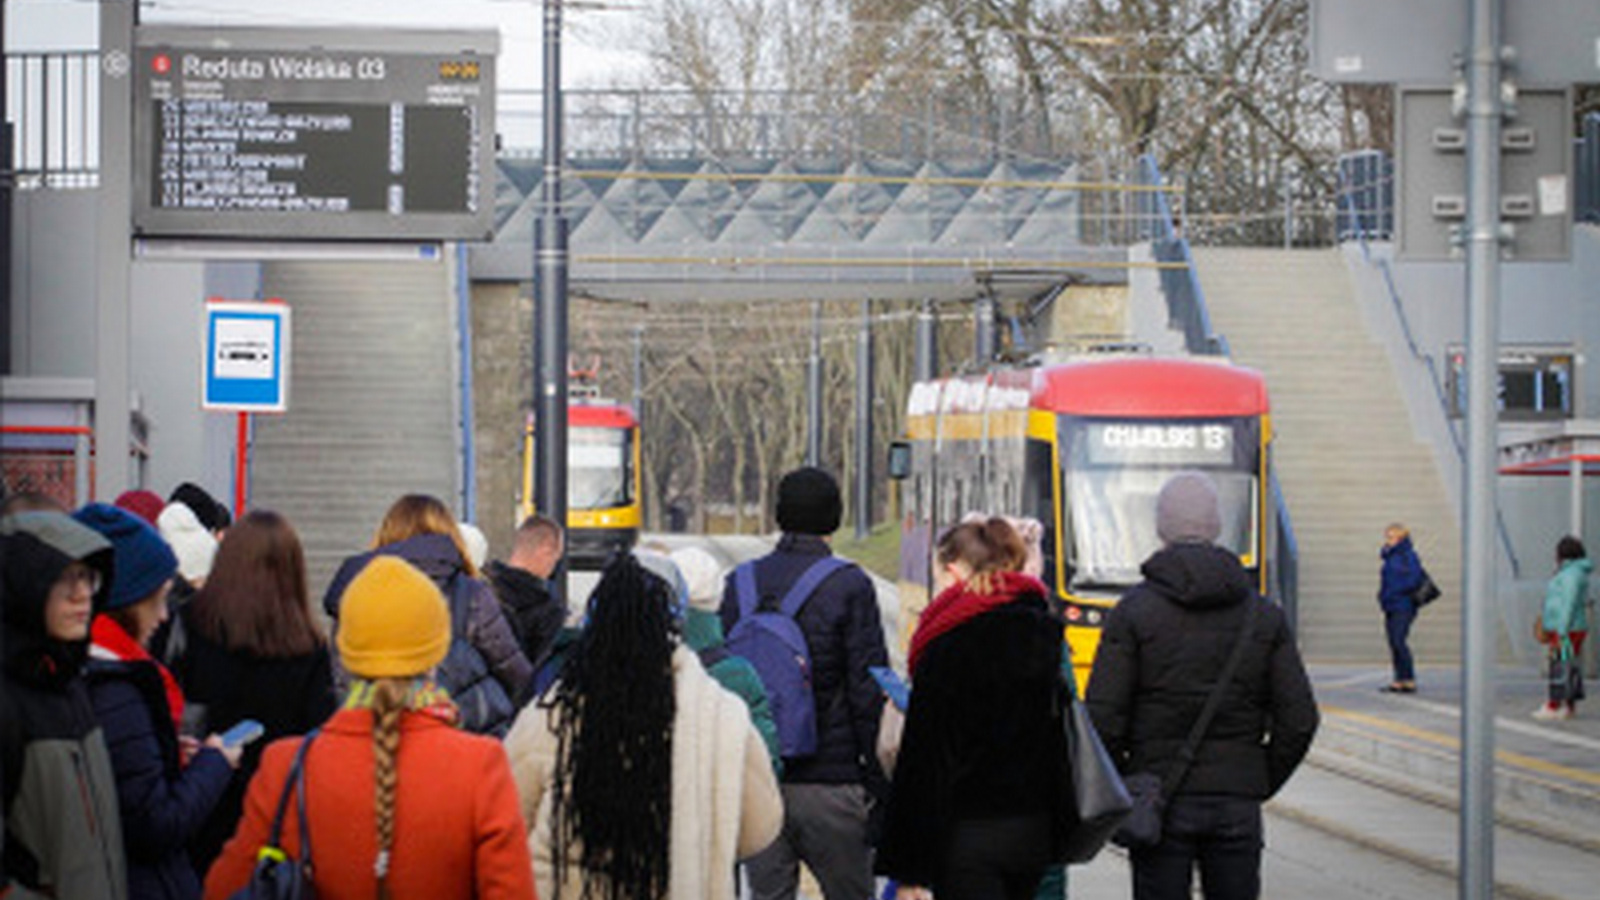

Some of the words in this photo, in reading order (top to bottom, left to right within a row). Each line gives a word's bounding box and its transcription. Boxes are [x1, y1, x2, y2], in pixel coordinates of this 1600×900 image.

[182, 55, 264, 79] Reduta
[269, 57, 352, 79] Wolska
[358, 57, 386, 79] 03
